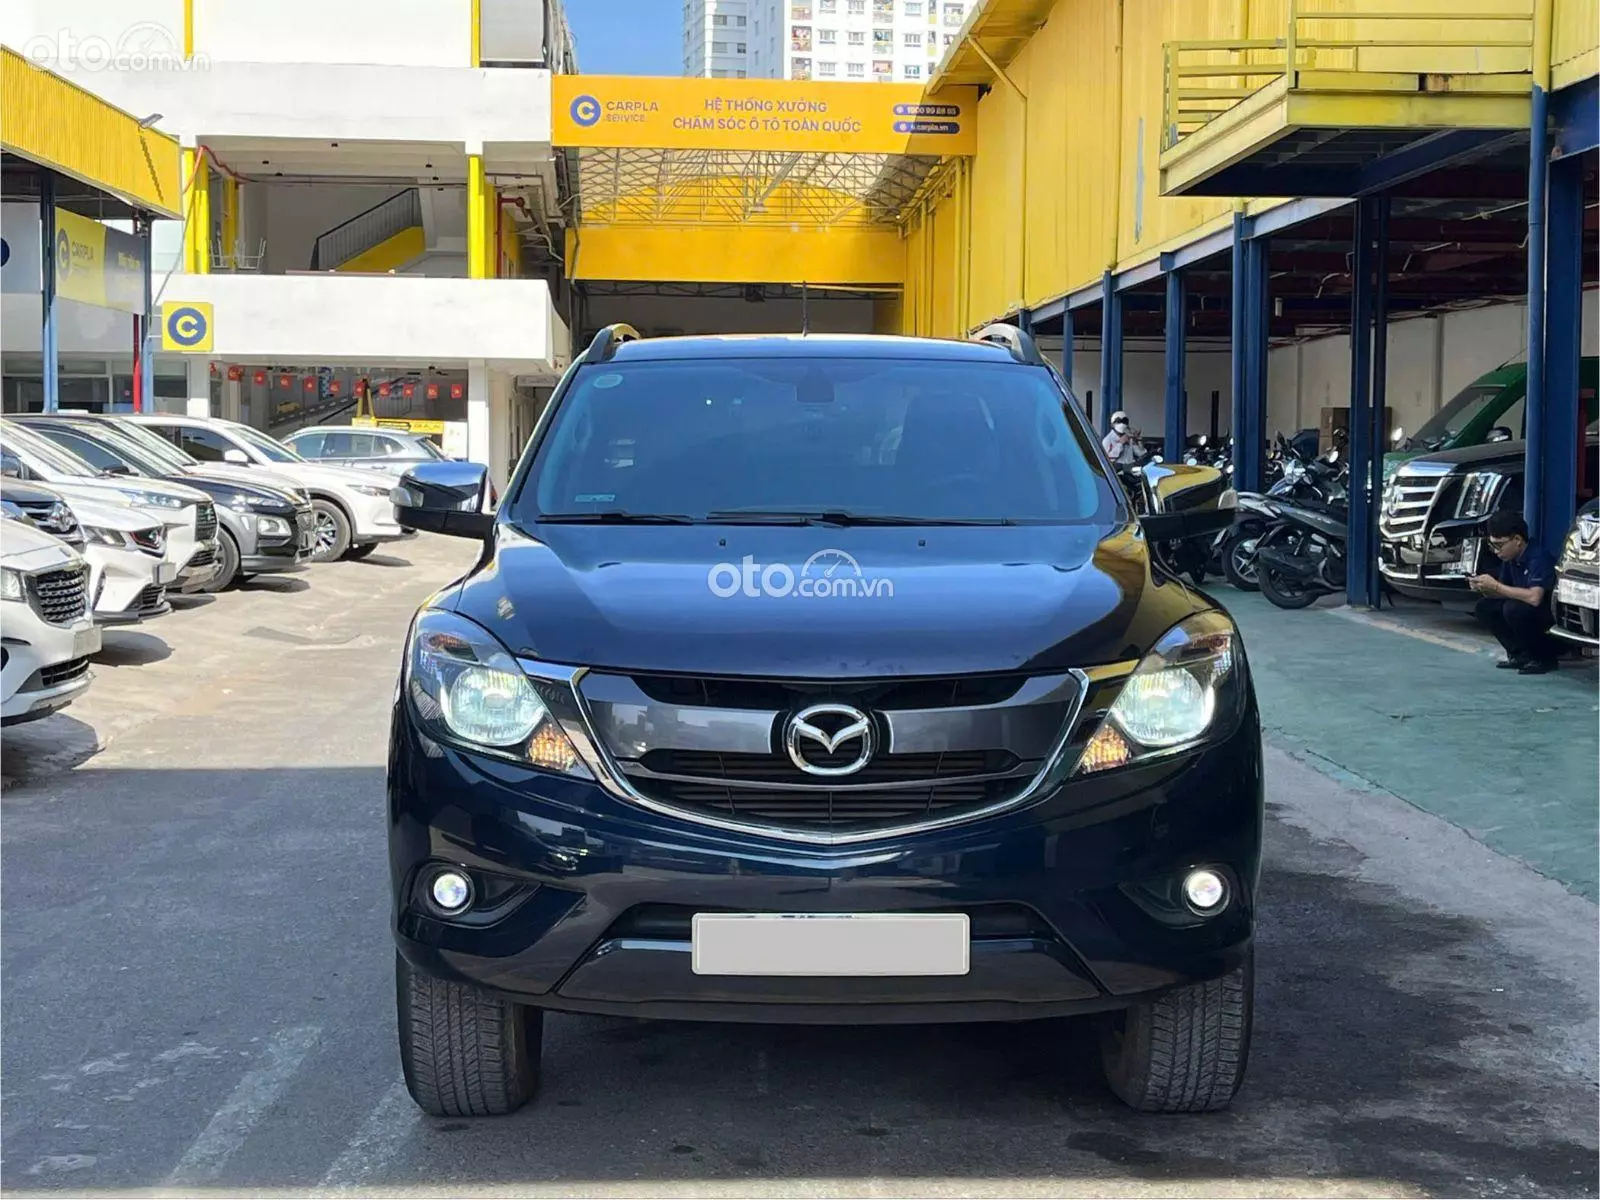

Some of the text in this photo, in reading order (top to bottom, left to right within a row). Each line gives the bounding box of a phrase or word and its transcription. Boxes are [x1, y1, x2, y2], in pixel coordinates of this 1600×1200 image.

[606, 101, 659, 112] CARPLA
[704, 95, 828, 113] HỆ THỐNG XƯỞNG
[606, 113, 646, 123] SERVICE
[672, 115, 861, 132] CHĂM SÓC Ô TÔ TOÀN QUỐC
